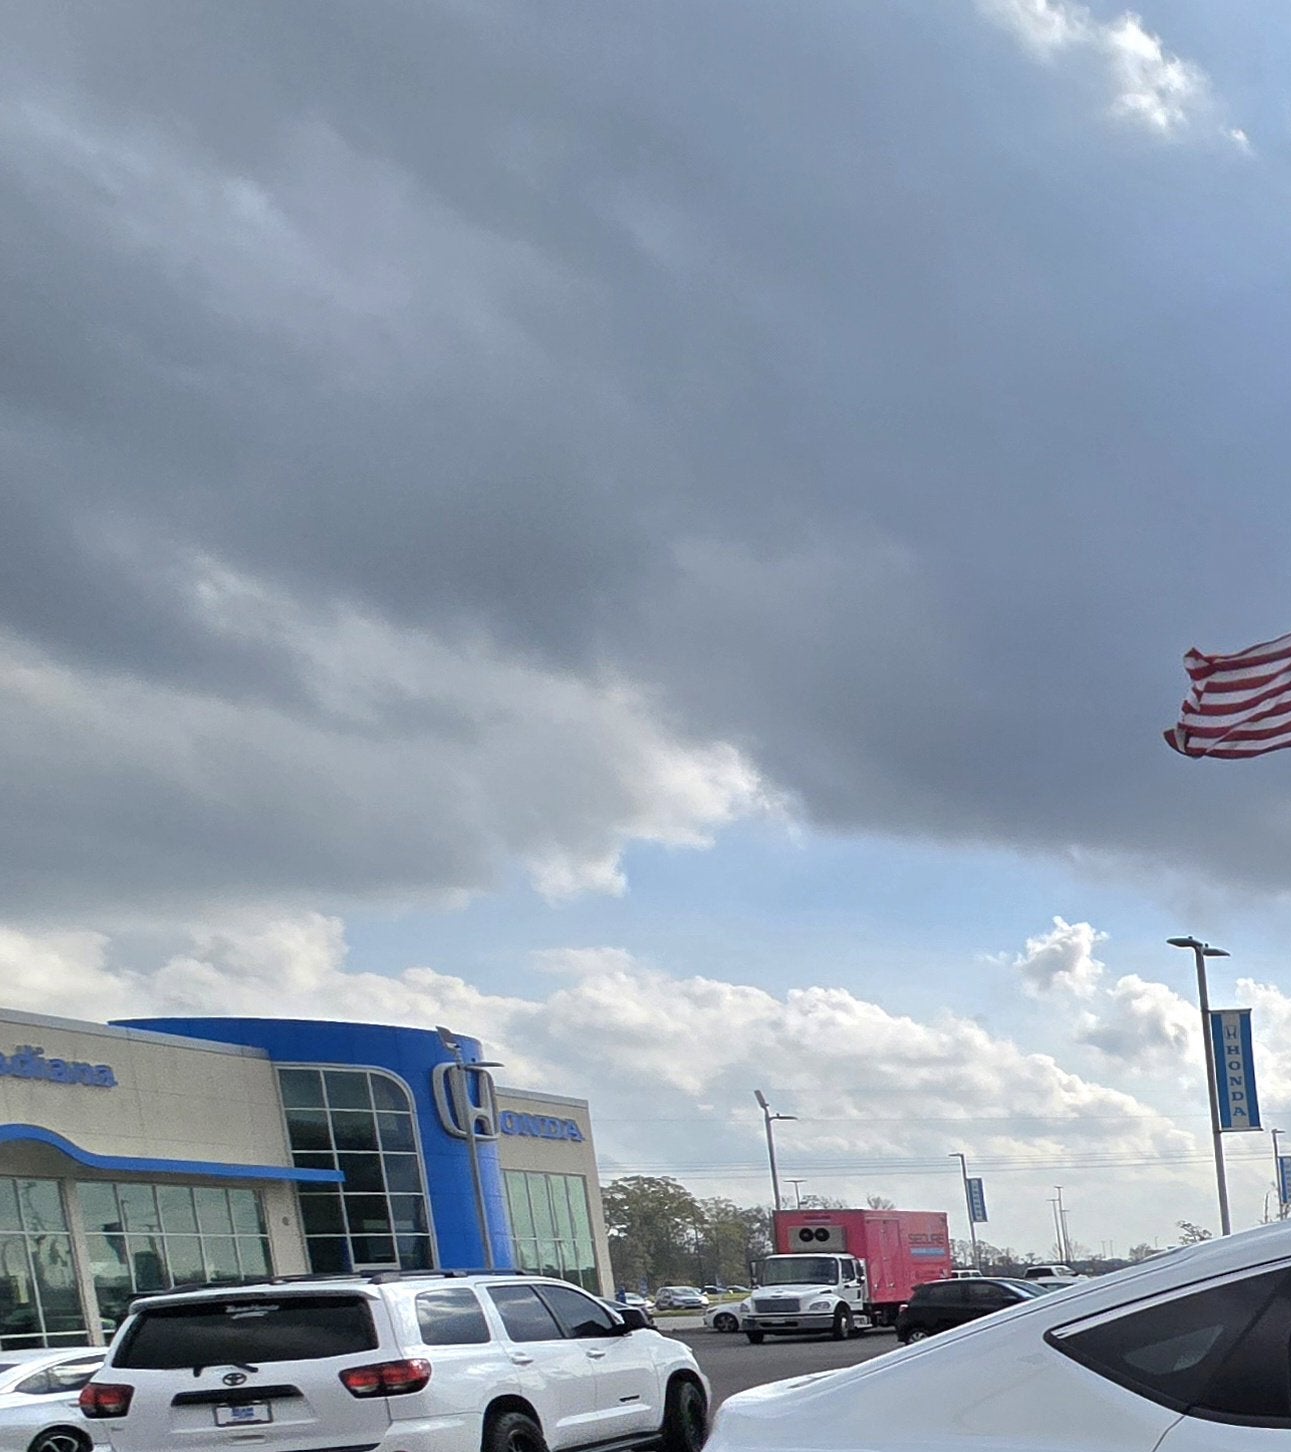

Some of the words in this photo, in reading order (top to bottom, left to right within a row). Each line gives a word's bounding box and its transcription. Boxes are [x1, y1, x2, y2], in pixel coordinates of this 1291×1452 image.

[0, 1045, 117, 1087] diana
[1226, 1045, 1247, 1117] HONDA
[501, 1109, 586, 1142] ONDA
